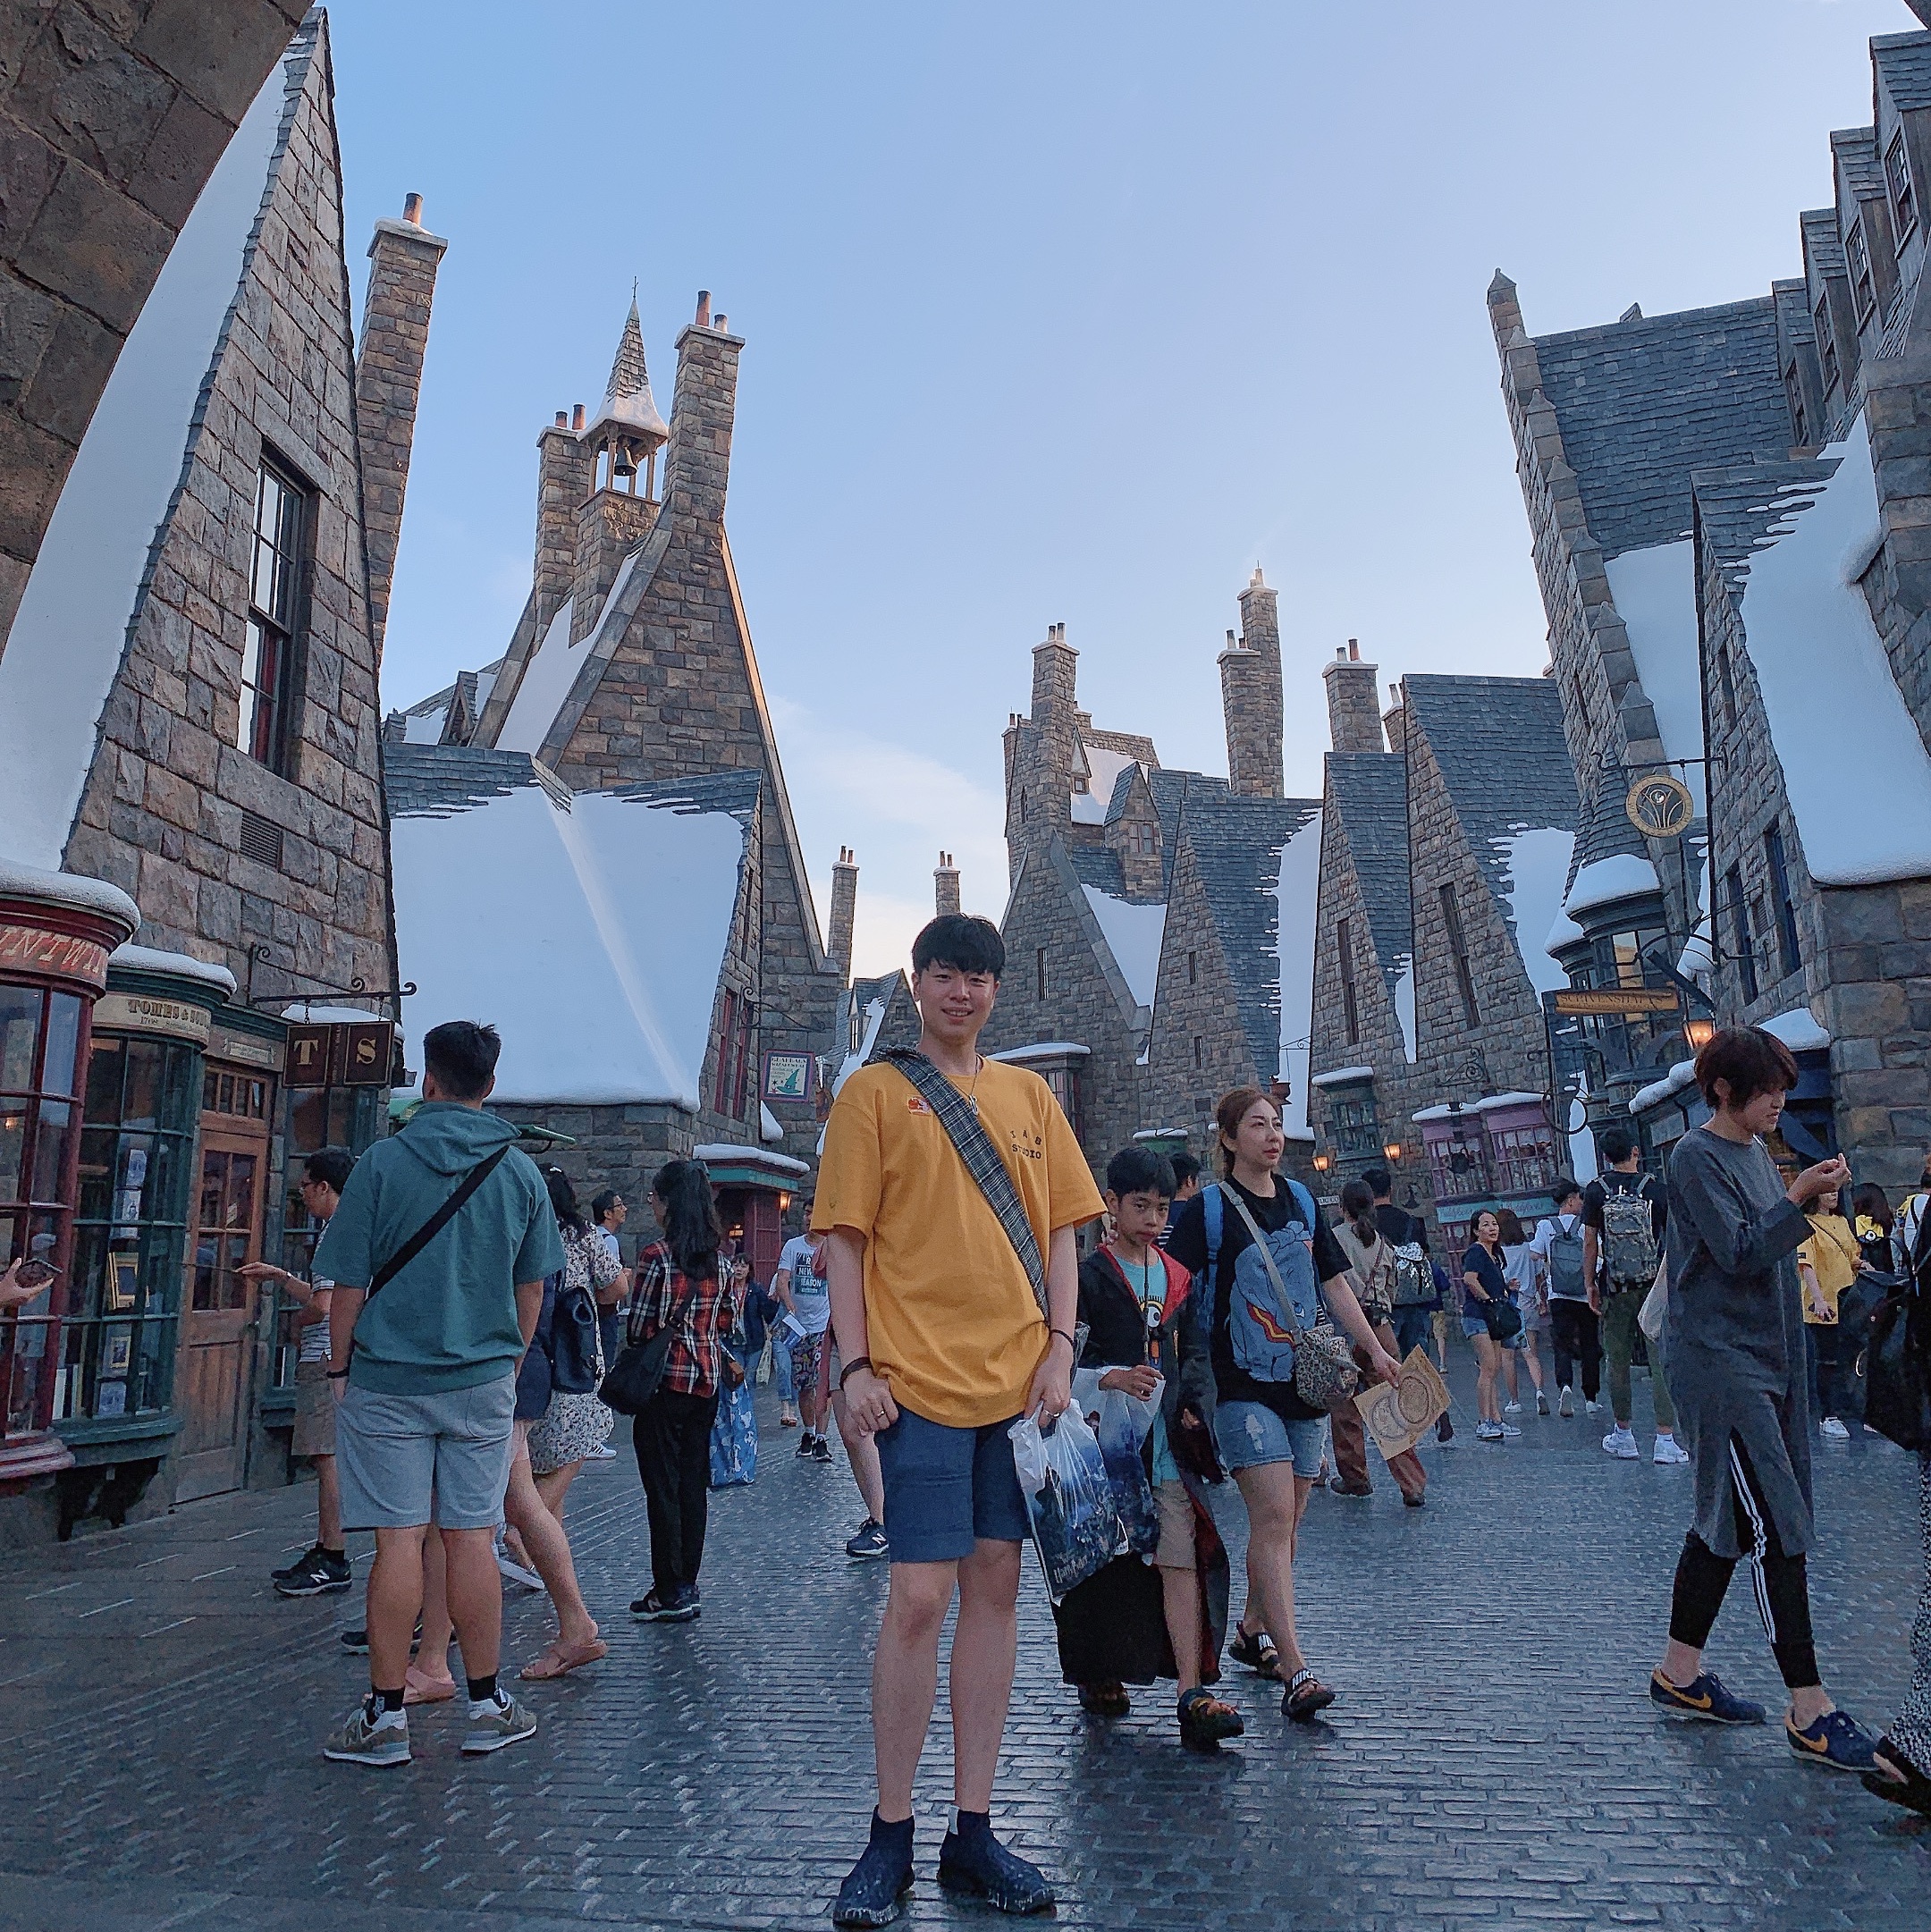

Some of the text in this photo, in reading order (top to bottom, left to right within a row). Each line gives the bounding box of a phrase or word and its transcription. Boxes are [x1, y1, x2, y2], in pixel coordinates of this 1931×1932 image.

[293, 1040, 318, 1065] T
[357, 1038, 375, 1064] S
[1012, 1143, 1041, 1159] STUDIO
